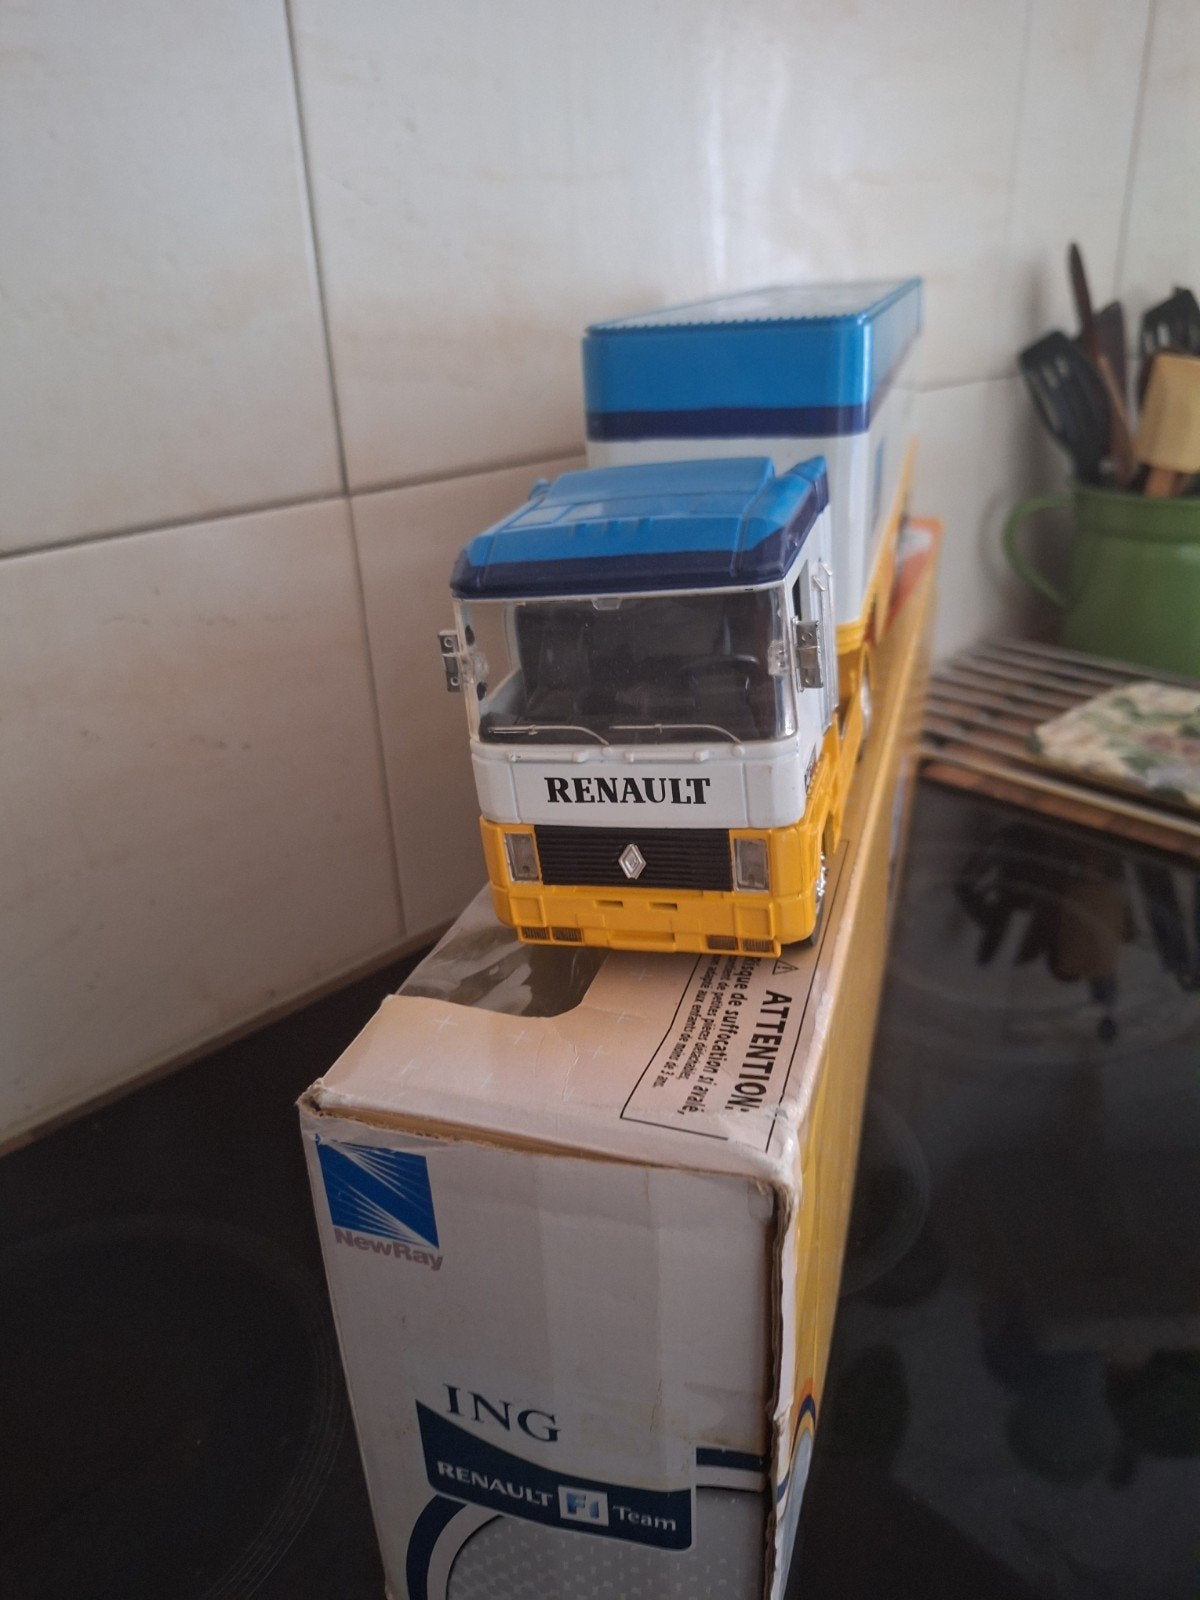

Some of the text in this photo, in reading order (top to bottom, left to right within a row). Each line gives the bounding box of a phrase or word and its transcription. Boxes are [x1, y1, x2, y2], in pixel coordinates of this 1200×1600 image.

[544, 777, 710, 804] RENAULT
[728, 993, 748, 1006] de
[703, 1010, 739, 1073] suffocation
[725, 990, 792, 1114] ATTENTION:
[698, 1075, 717, 1085] si
[334, 1228, 443, 1271] NewRay
[442, 1384, 561, 1442] ING
[437, 1461, 676, 1531] RENAULT F1 Team
